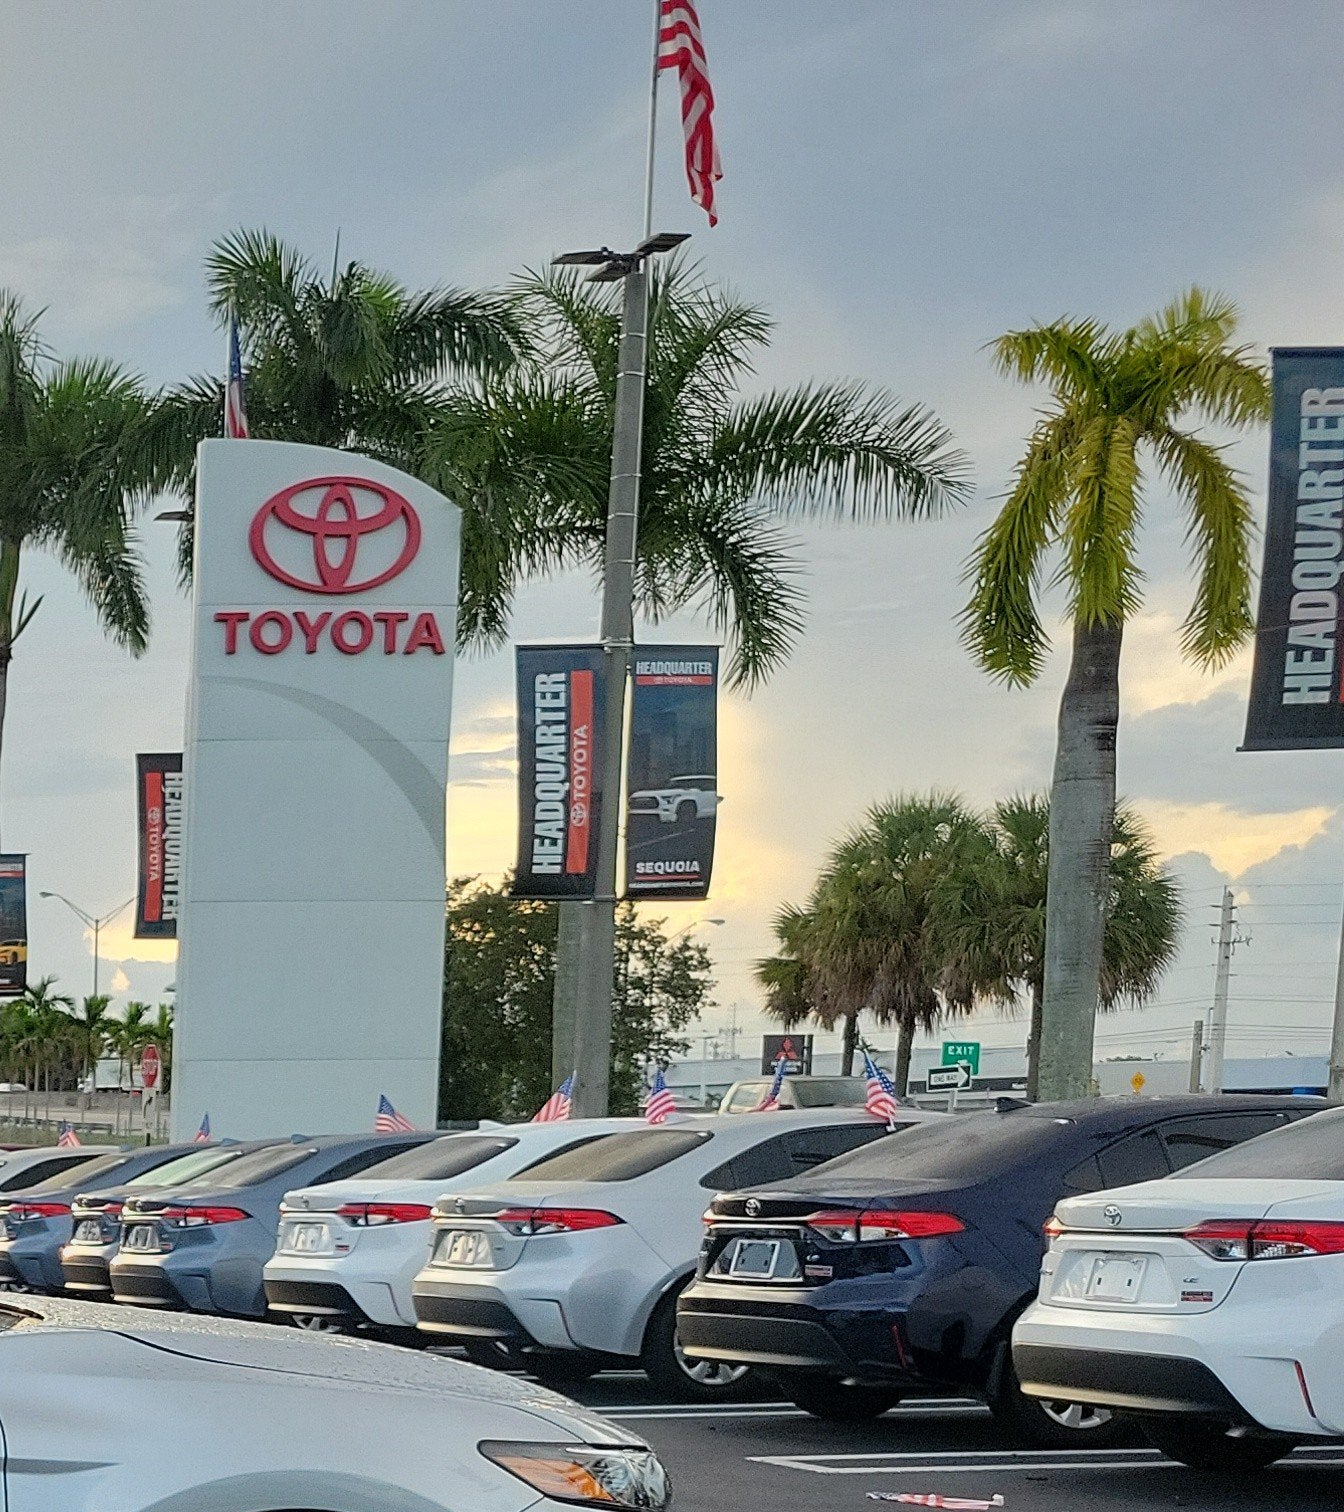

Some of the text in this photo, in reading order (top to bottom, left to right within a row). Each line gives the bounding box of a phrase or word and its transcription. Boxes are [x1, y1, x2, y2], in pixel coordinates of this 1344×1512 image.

[1282, 387, 1344, 704] HEADQUARTER
[214, 611, 445, 655] TOYOTA
[636, 661, 712, 676] HEADQUARTER
[531, 672, 569, 874] HEADQUARTER
[573, 725, 589, 801] TOYOTA
[149, 824, 161, 881] TOYOTA
[636, 861, 700, 874] SEQUOIA
[948, 1046, 974, 1055] EXIT
